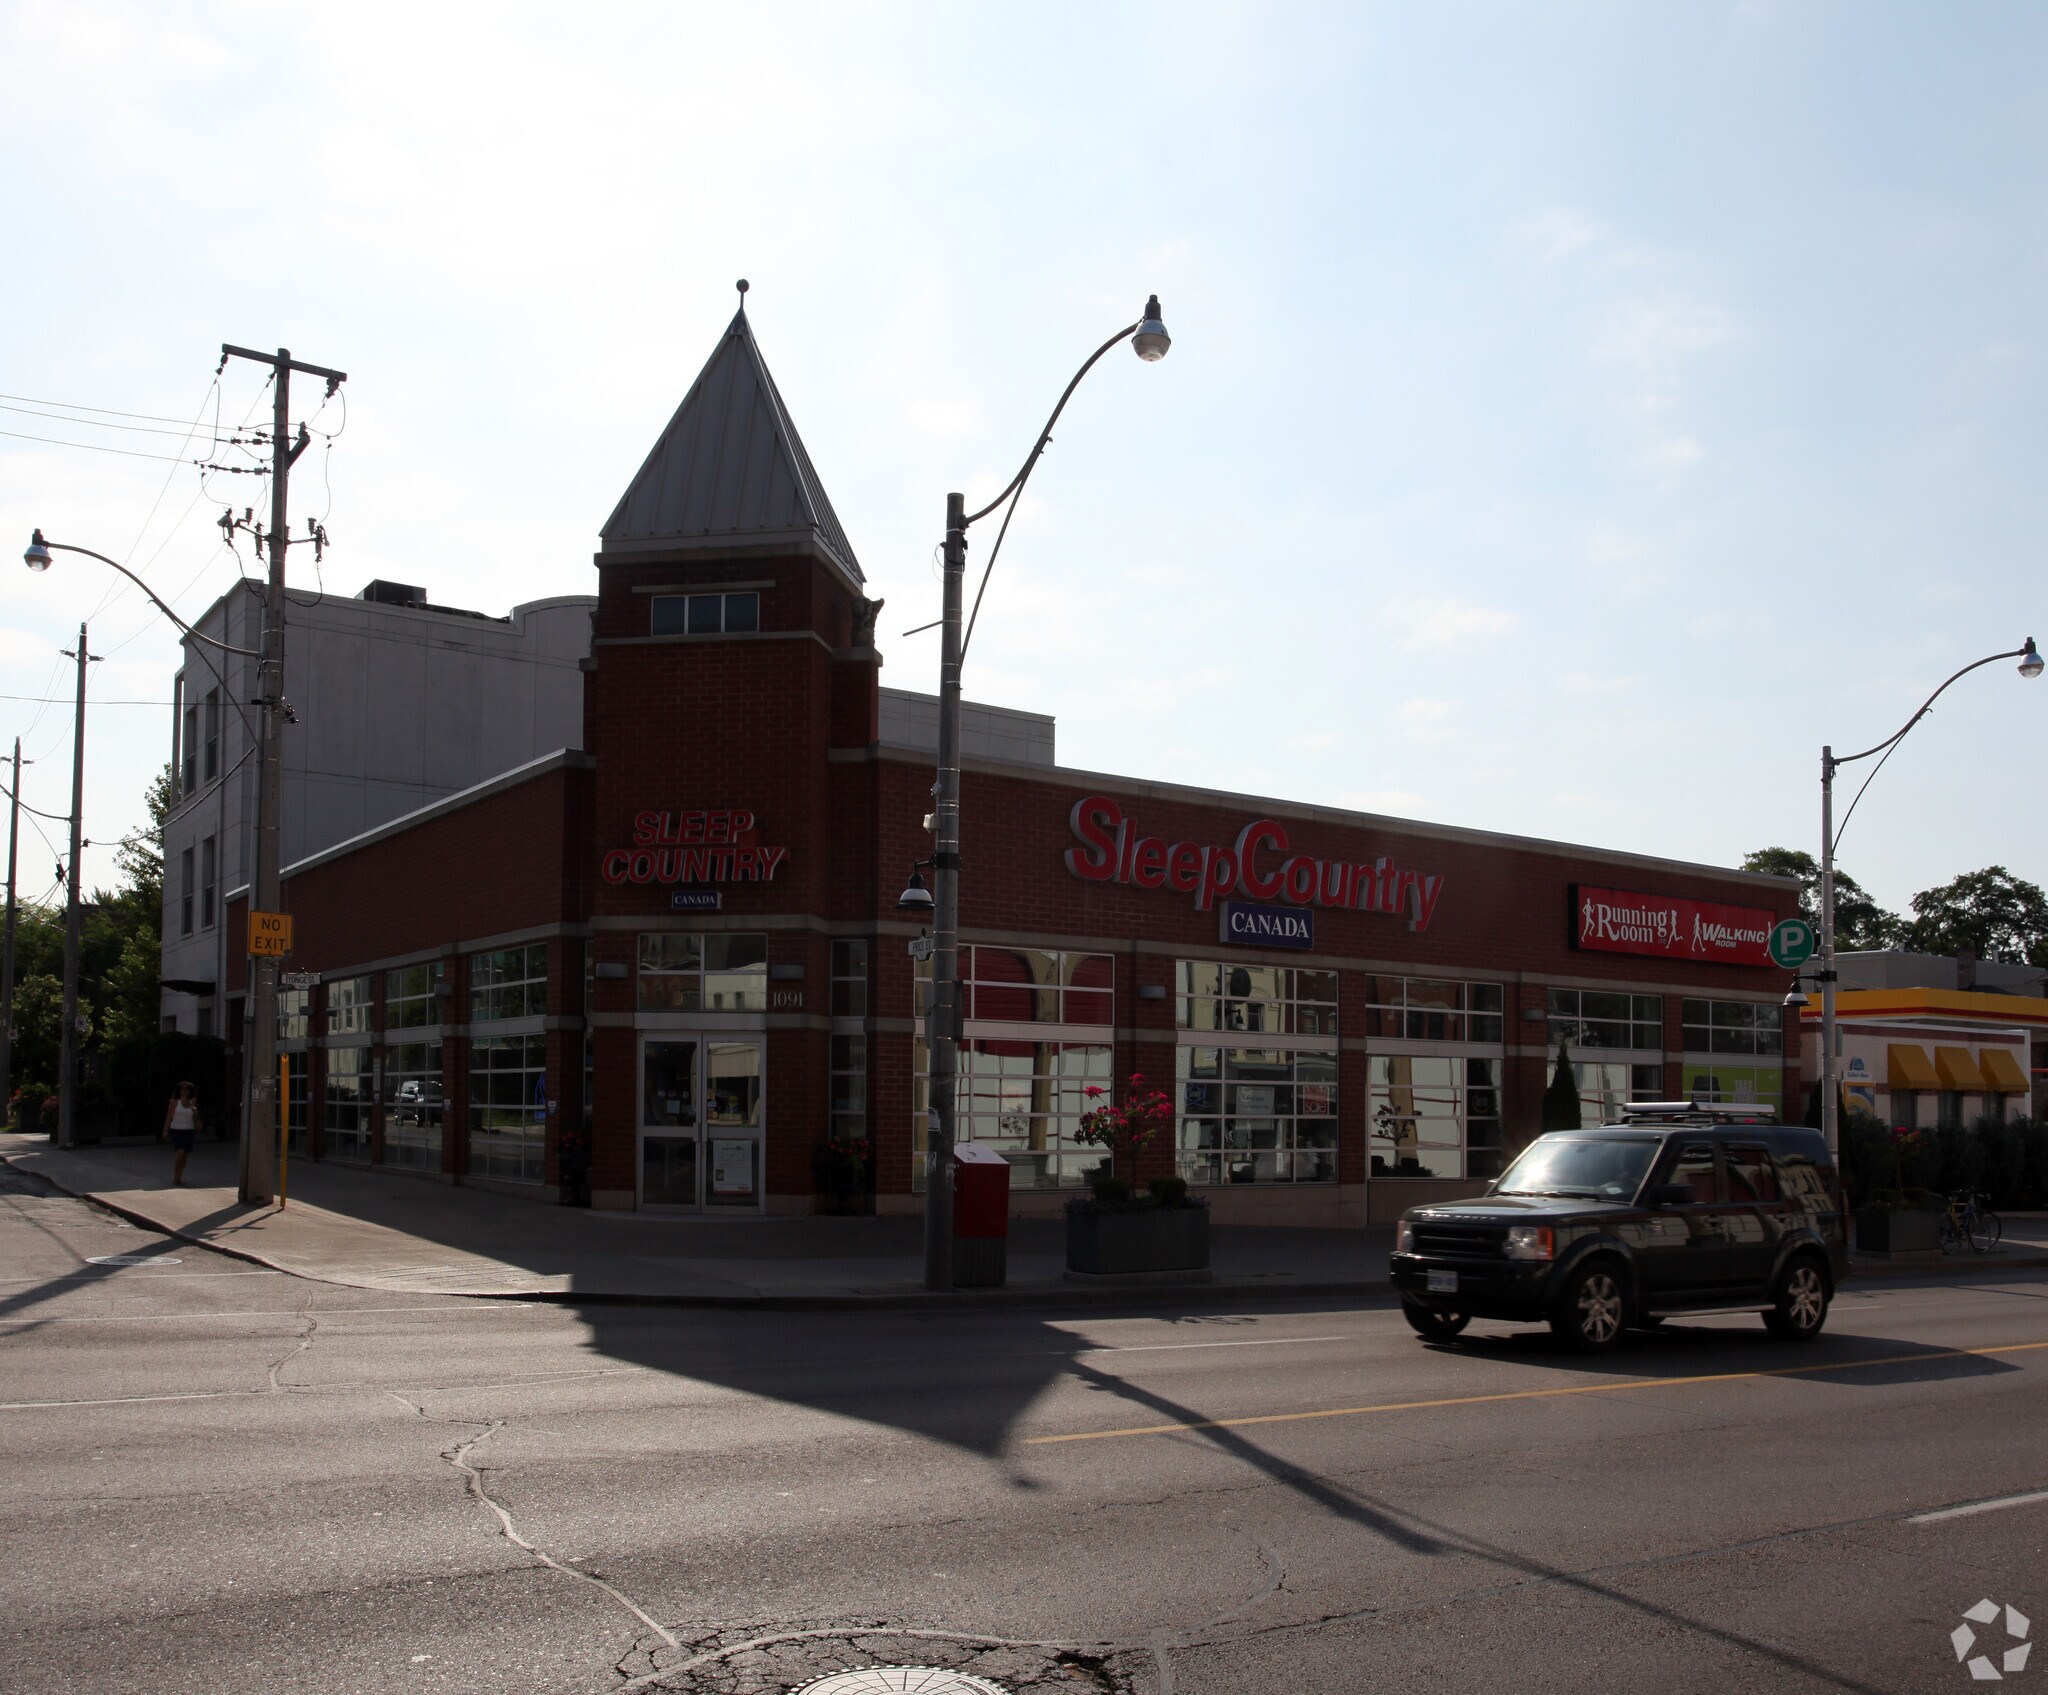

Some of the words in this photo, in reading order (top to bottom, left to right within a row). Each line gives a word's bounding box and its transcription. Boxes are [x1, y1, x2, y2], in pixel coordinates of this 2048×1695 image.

[633, 810, 754, 845] SLEEP
[602, 847, 786, 884] COUNTRY
[674, 895, 716, 905] CANADA
[261, 918, 281, 931] NO
[1230, 911, 1309, 939] CANADA
[1596, 903, 1667, 941] Running
[1702, 923, 1766, 944] WALKING
[1781, 926, 1804, 955] P
[255, 936, 286, 951] EXIT
[1715, 940, 1737, 949] ROOM
[287, 976, 307, 984] YONGE
[773, 991, 803, 1007] 1091
